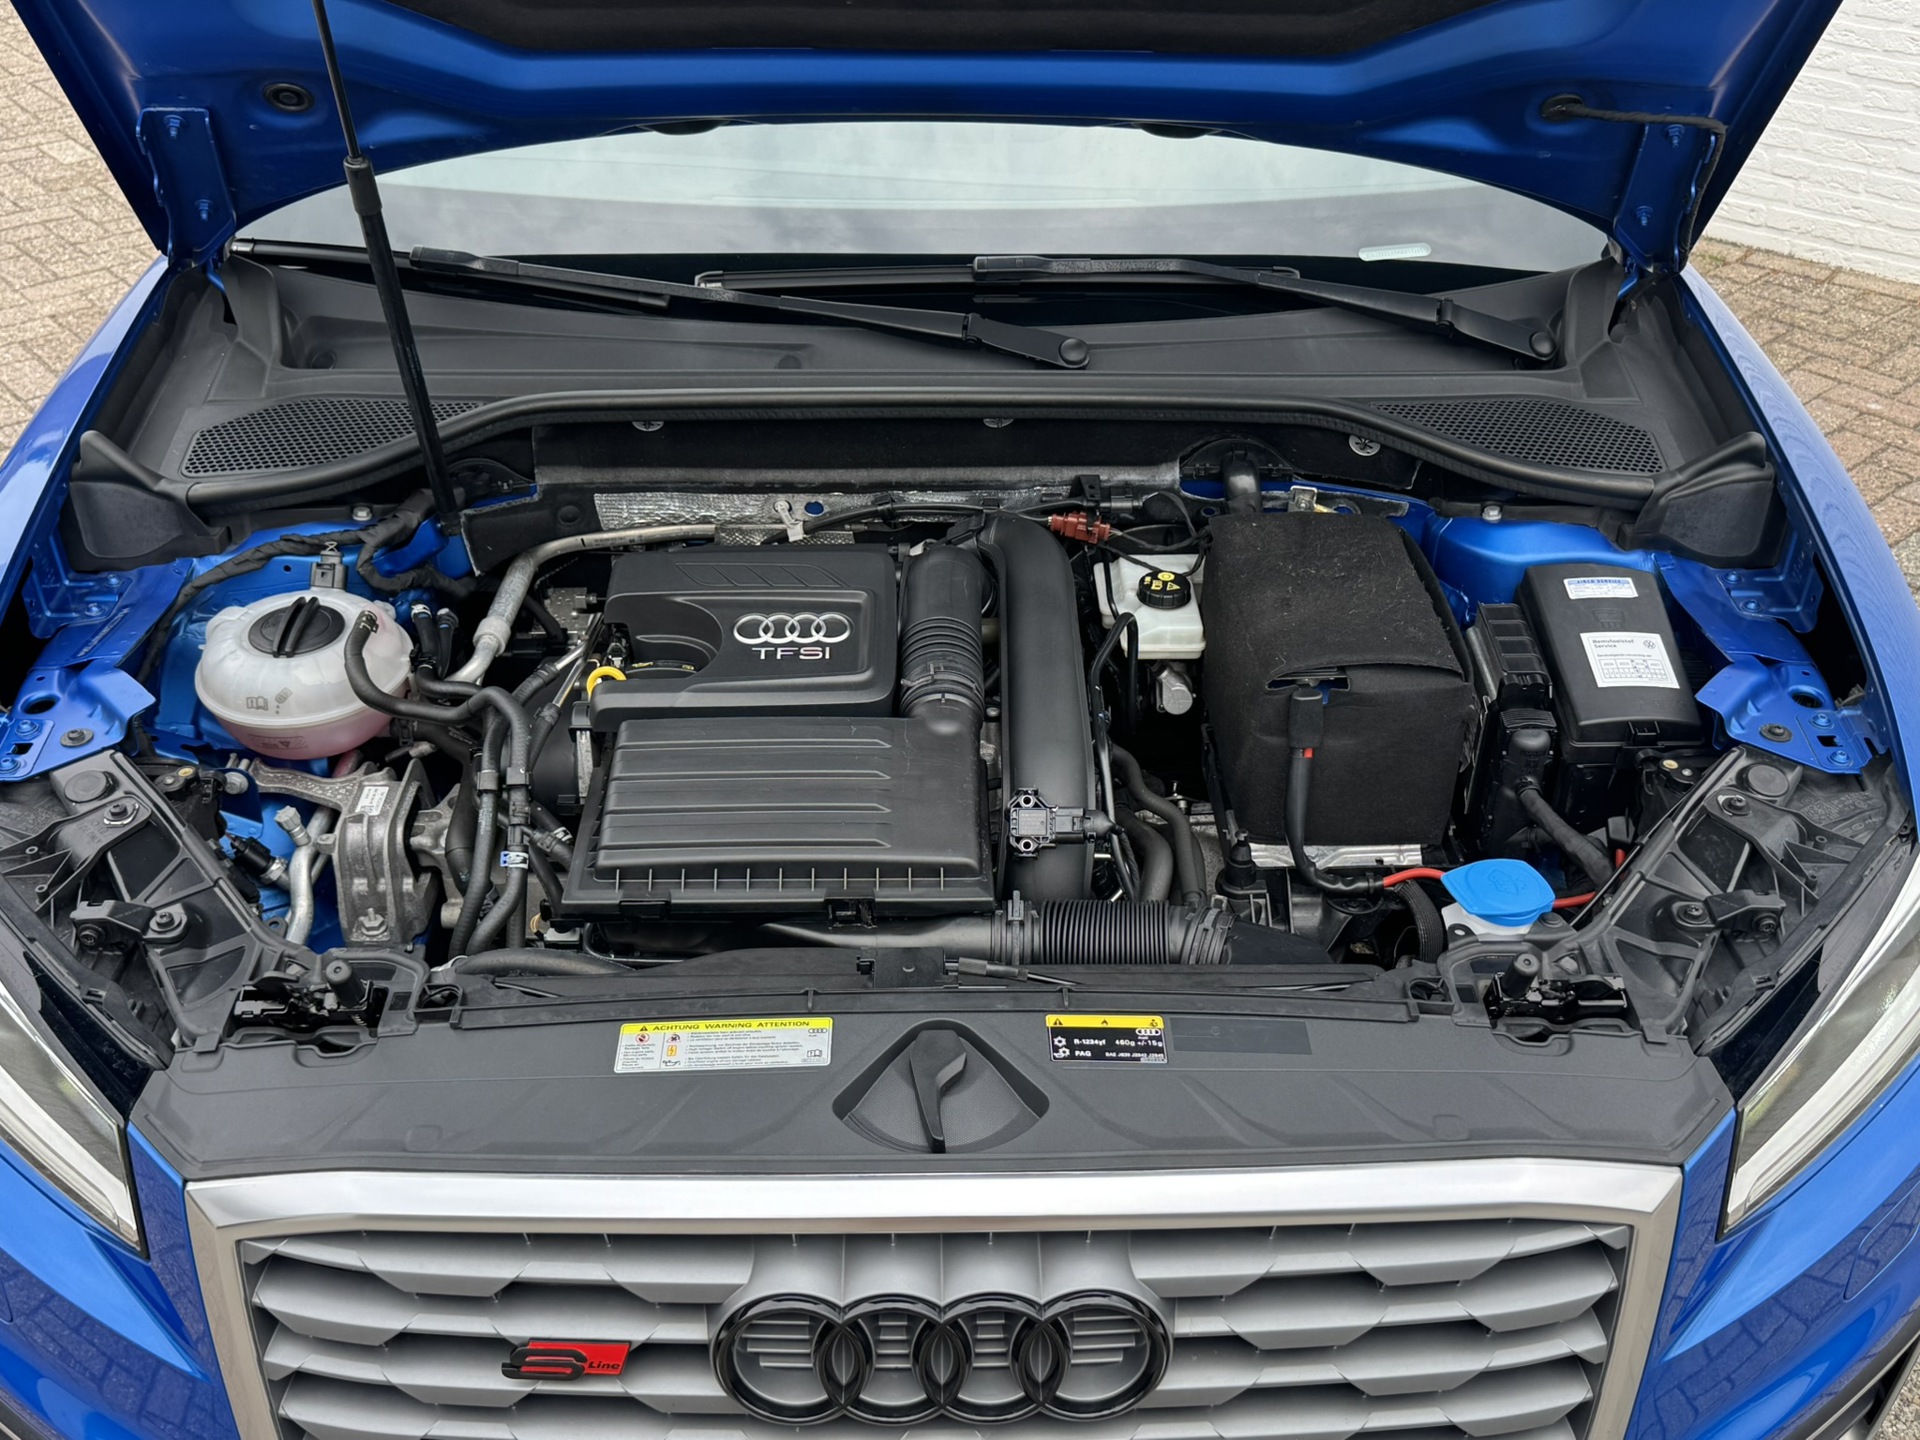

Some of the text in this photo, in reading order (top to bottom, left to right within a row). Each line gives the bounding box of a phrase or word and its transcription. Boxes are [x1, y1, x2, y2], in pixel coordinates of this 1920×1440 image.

[752, 647, 830, 660] TFSI
[652, 1020, 810, 1032] ACHTUNG WARNING ATTENTION
[1073, 1038, 1106, 1047] R-1234yf
[1115, 1039, 1136, 1047] 460g
[501, 1347, 620, 1381] S Line
